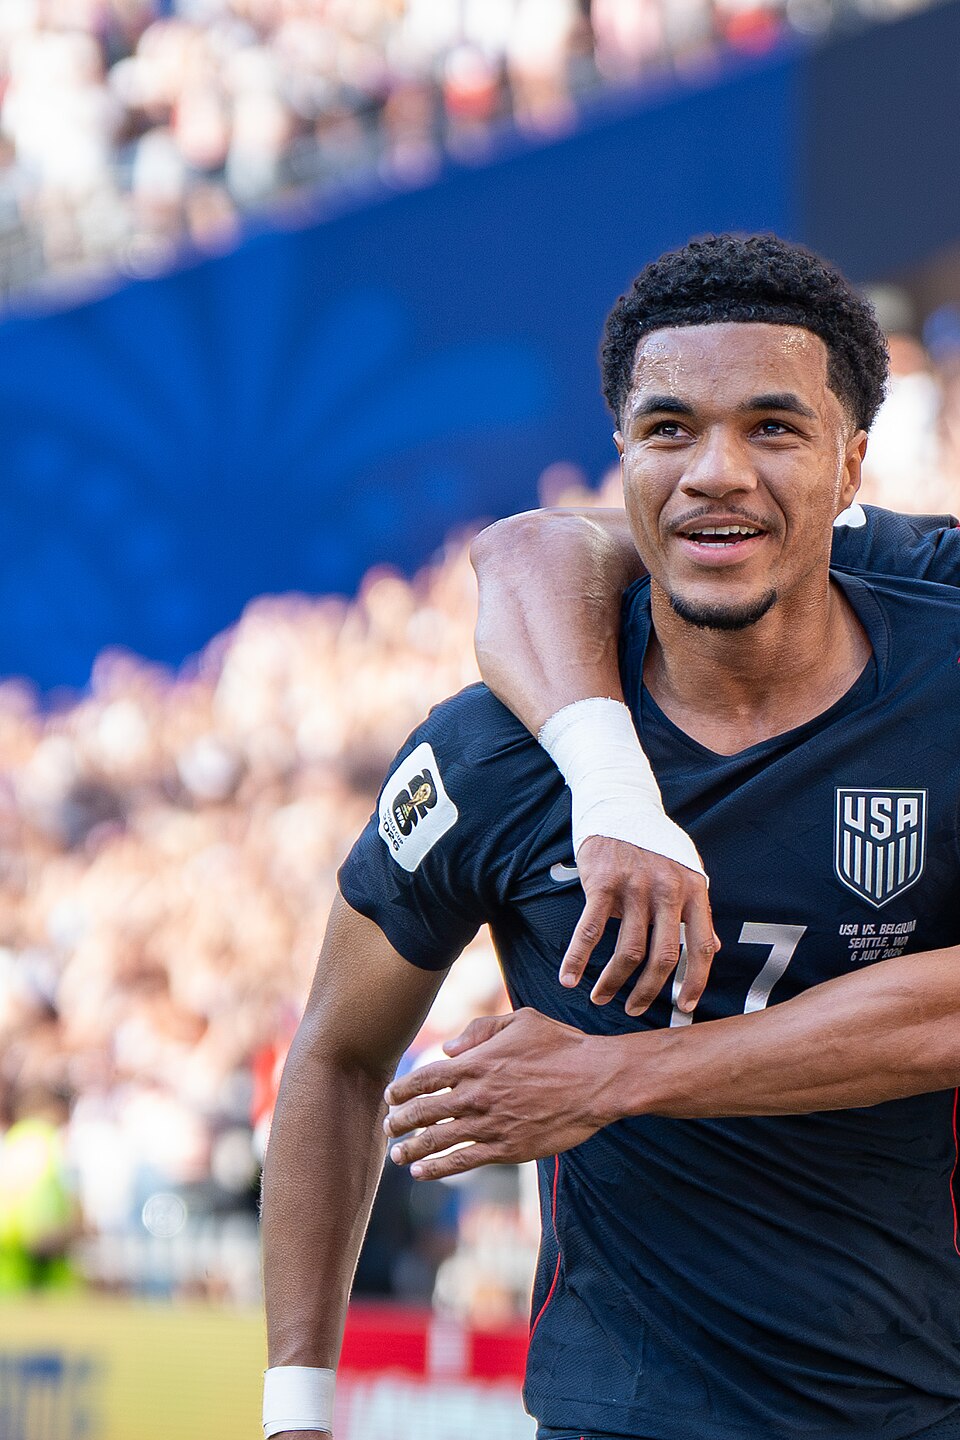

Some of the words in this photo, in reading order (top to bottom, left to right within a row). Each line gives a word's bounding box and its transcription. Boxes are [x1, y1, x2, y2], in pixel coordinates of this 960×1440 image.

[844, 796, 919, 841] USA
[839, 923, 859, 936] USA
[861, 923, 876, 935] VS.
[879, 919, 917, 935] BELGIUM
[848, 936, 890, 949] SEATTLE,
[850, 950, 858, 961] 6
[859, 949, 881, 961] JULY
